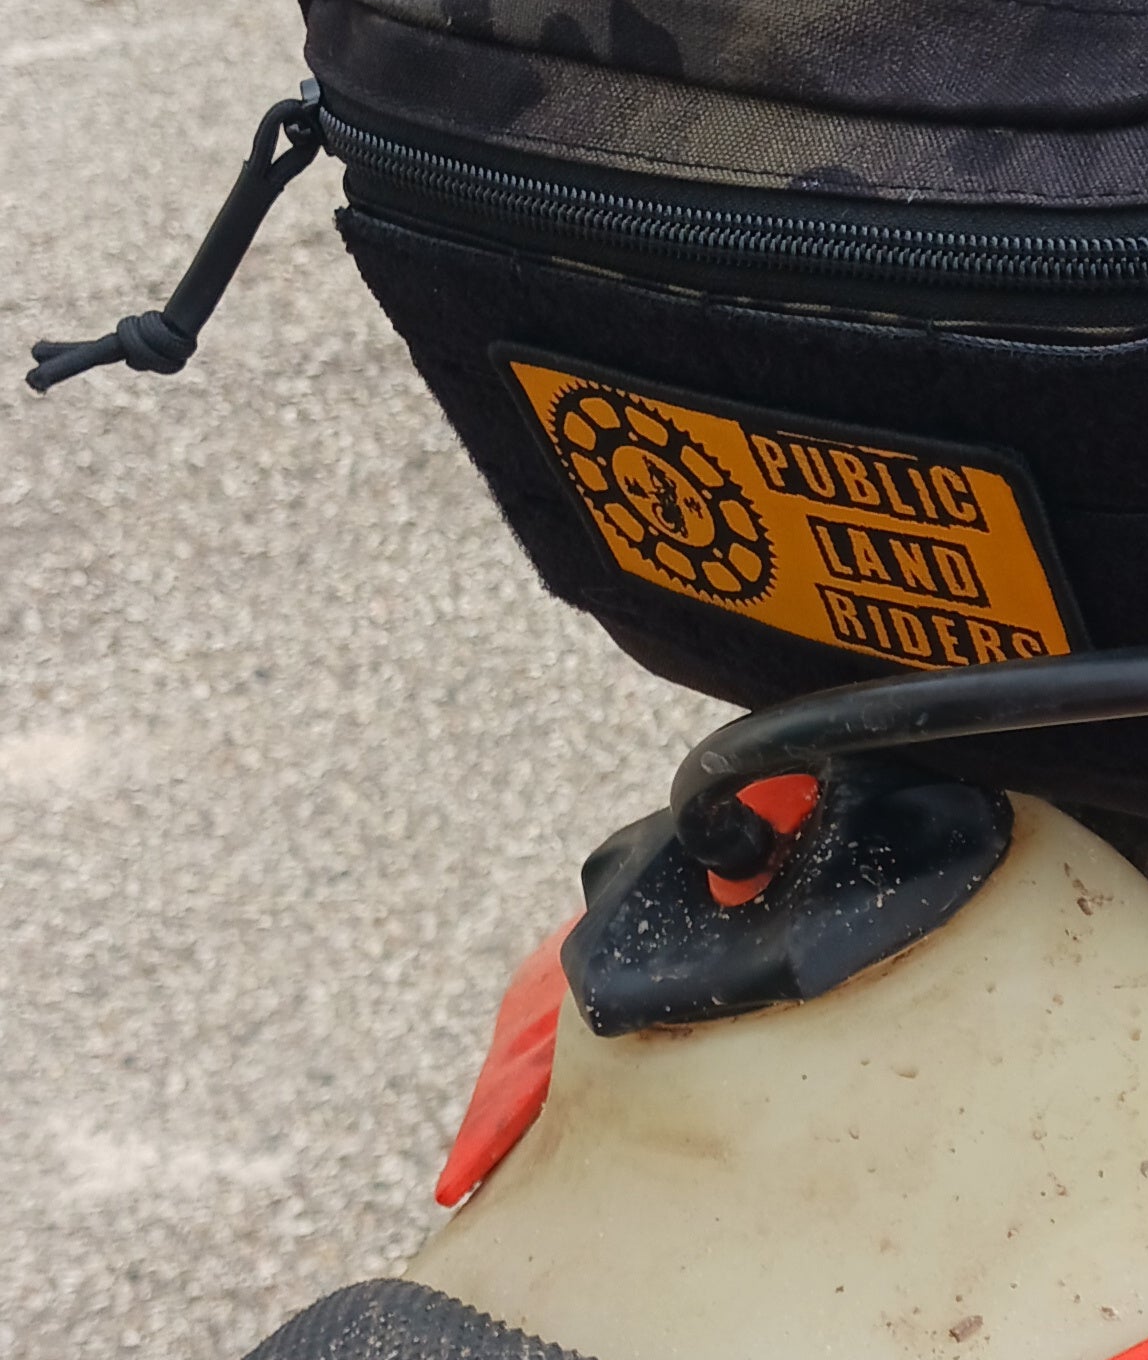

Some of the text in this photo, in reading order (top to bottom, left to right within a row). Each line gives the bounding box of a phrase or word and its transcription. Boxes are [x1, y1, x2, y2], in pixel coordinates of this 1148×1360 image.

[751, 435, 981, 523] PUBLIC
[814, 524, 980, 598] LAND
[825, 589, 1044, 666] RIDERS
